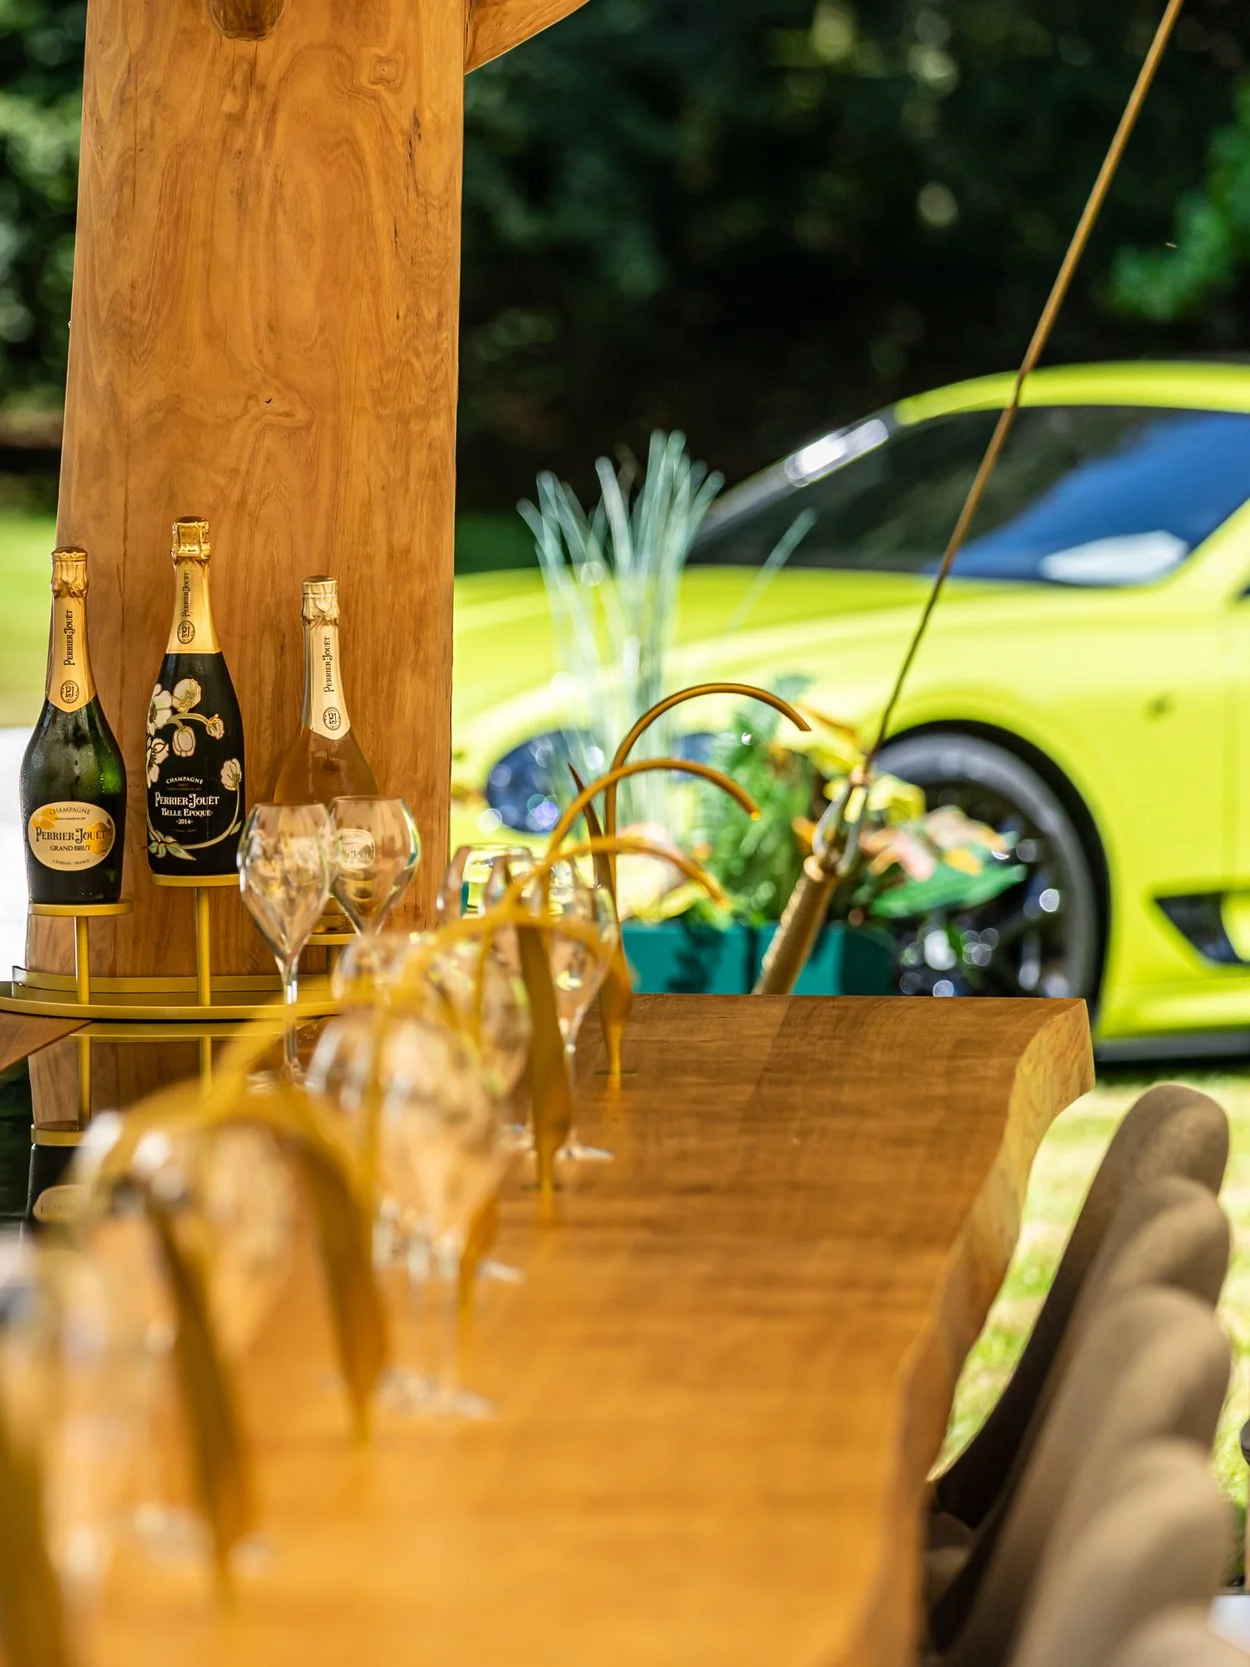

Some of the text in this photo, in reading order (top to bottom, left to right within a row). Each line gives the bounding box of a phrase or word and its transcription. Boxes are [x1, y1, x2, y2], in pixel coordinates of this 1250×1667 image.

[165, 776, 204, 785] CHAMPAGNE
[49, 806, 91, 815] CHAMPAGNE
[161, 808, 182, 817] BELLE
